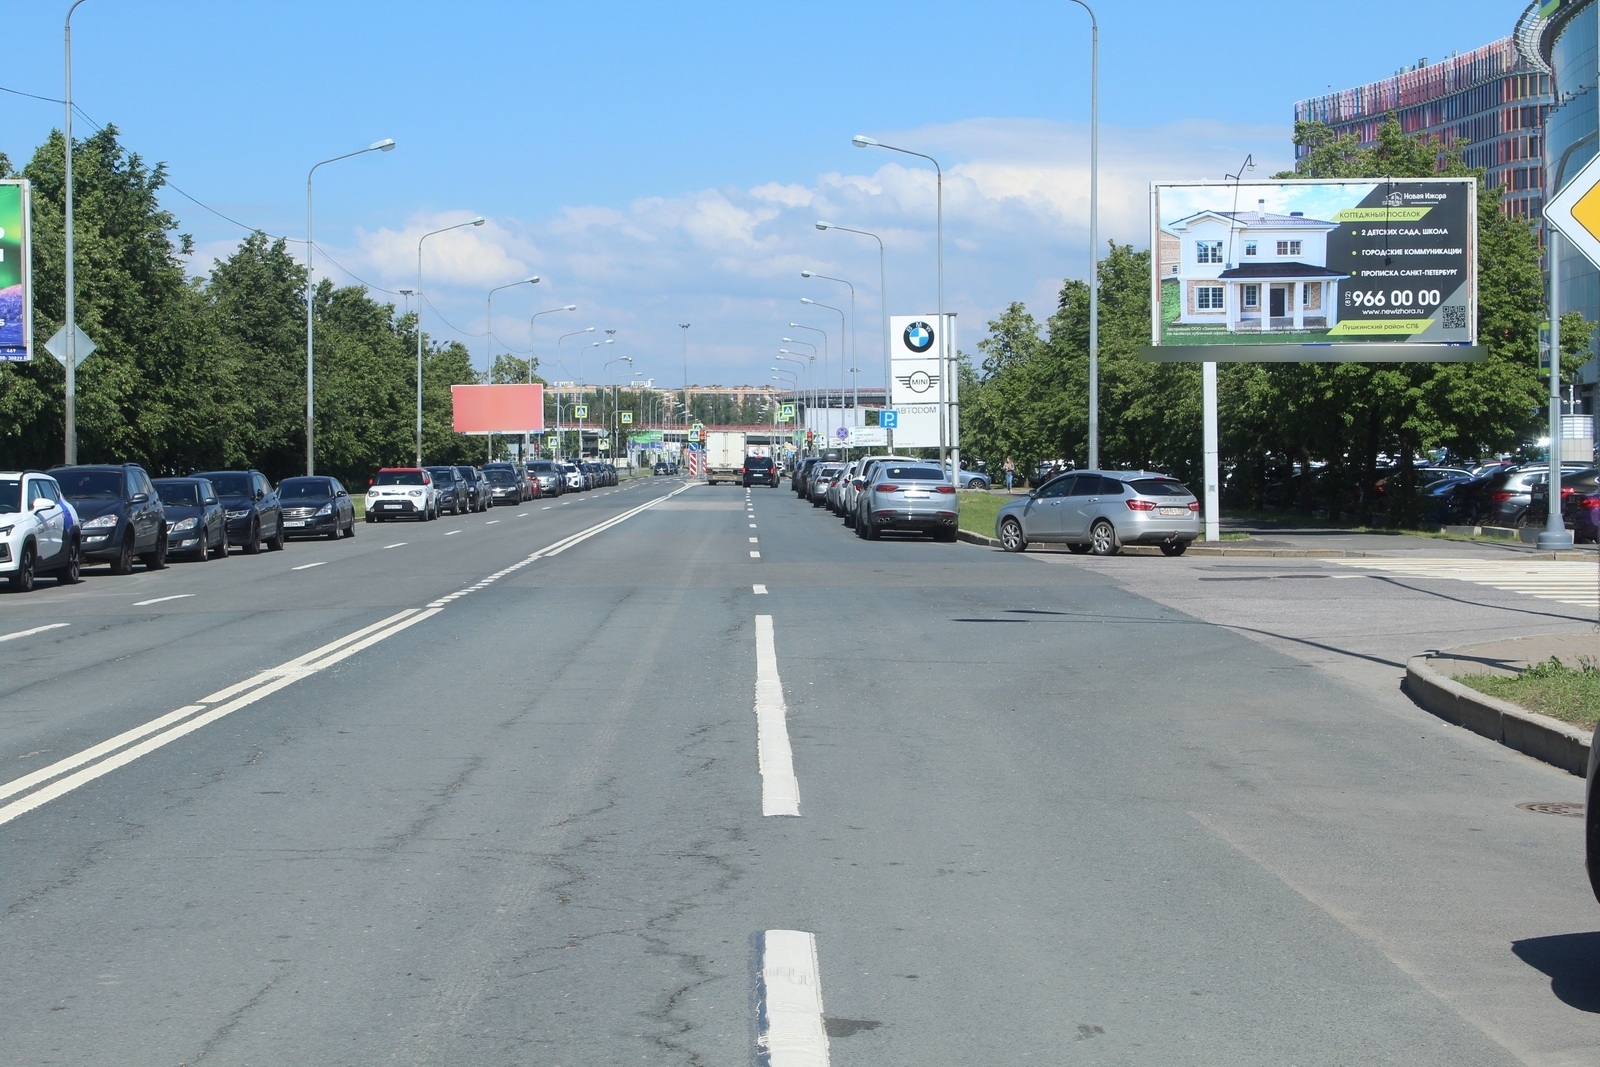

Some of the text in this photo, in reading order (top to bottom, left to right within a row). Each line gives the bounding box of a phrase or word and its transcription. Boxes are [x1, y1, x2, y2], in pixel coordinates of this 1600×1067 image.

[1425, 193, 1447, 201] Ижора
[1340, 210, 1386, 219] КОТТЕДЖНЫЙ
[1367, 229, 1398, 237] ДЕТСКИХ
[1398, 228, 1421, 236] САДА,
[1404, 248, 1463, 256] КОММУНИКАЦИИ
[1352, 290, 1386, 307] 966
[1390, 289, 1413, 306] 00
[1418, 289, 1441, 306] 00
[906, 321, 932, 333] BMW
[1384, 323, 1405, 331] район
